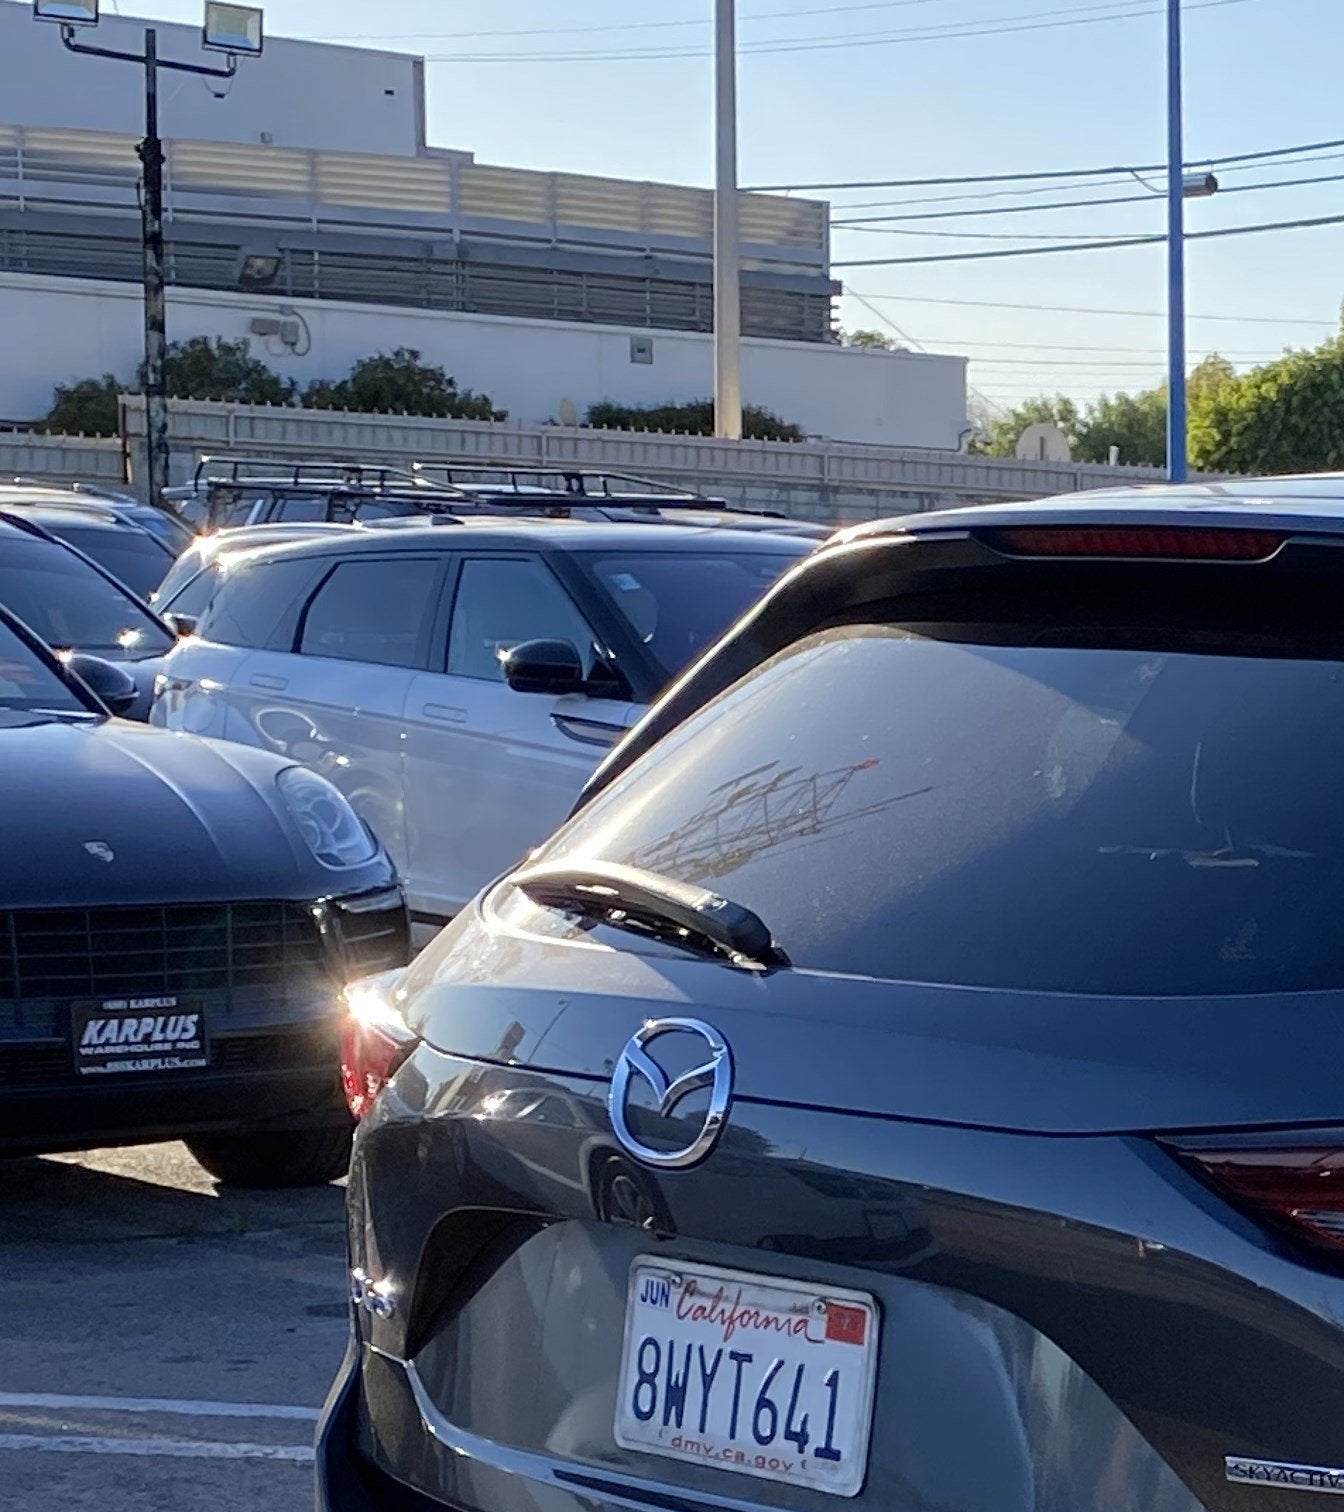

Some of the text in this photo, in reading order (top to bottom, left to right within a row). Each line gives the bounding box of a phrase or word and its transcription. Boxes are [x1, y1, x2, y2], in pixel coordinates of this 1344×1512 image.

[129, 997, 177, 1009] KARPLUS
[81, 1013, 199, 1046] KARPLUS
[79, 1042, 172, 1055] WAREHOUSE
[640, 1278, 671, 1309] JUN
[675, 1279, 825, 1344] California
[631, 1336, 842, 1463] 8WYT641
[670, 1435, 794, 1473] dmv.ca.gov
